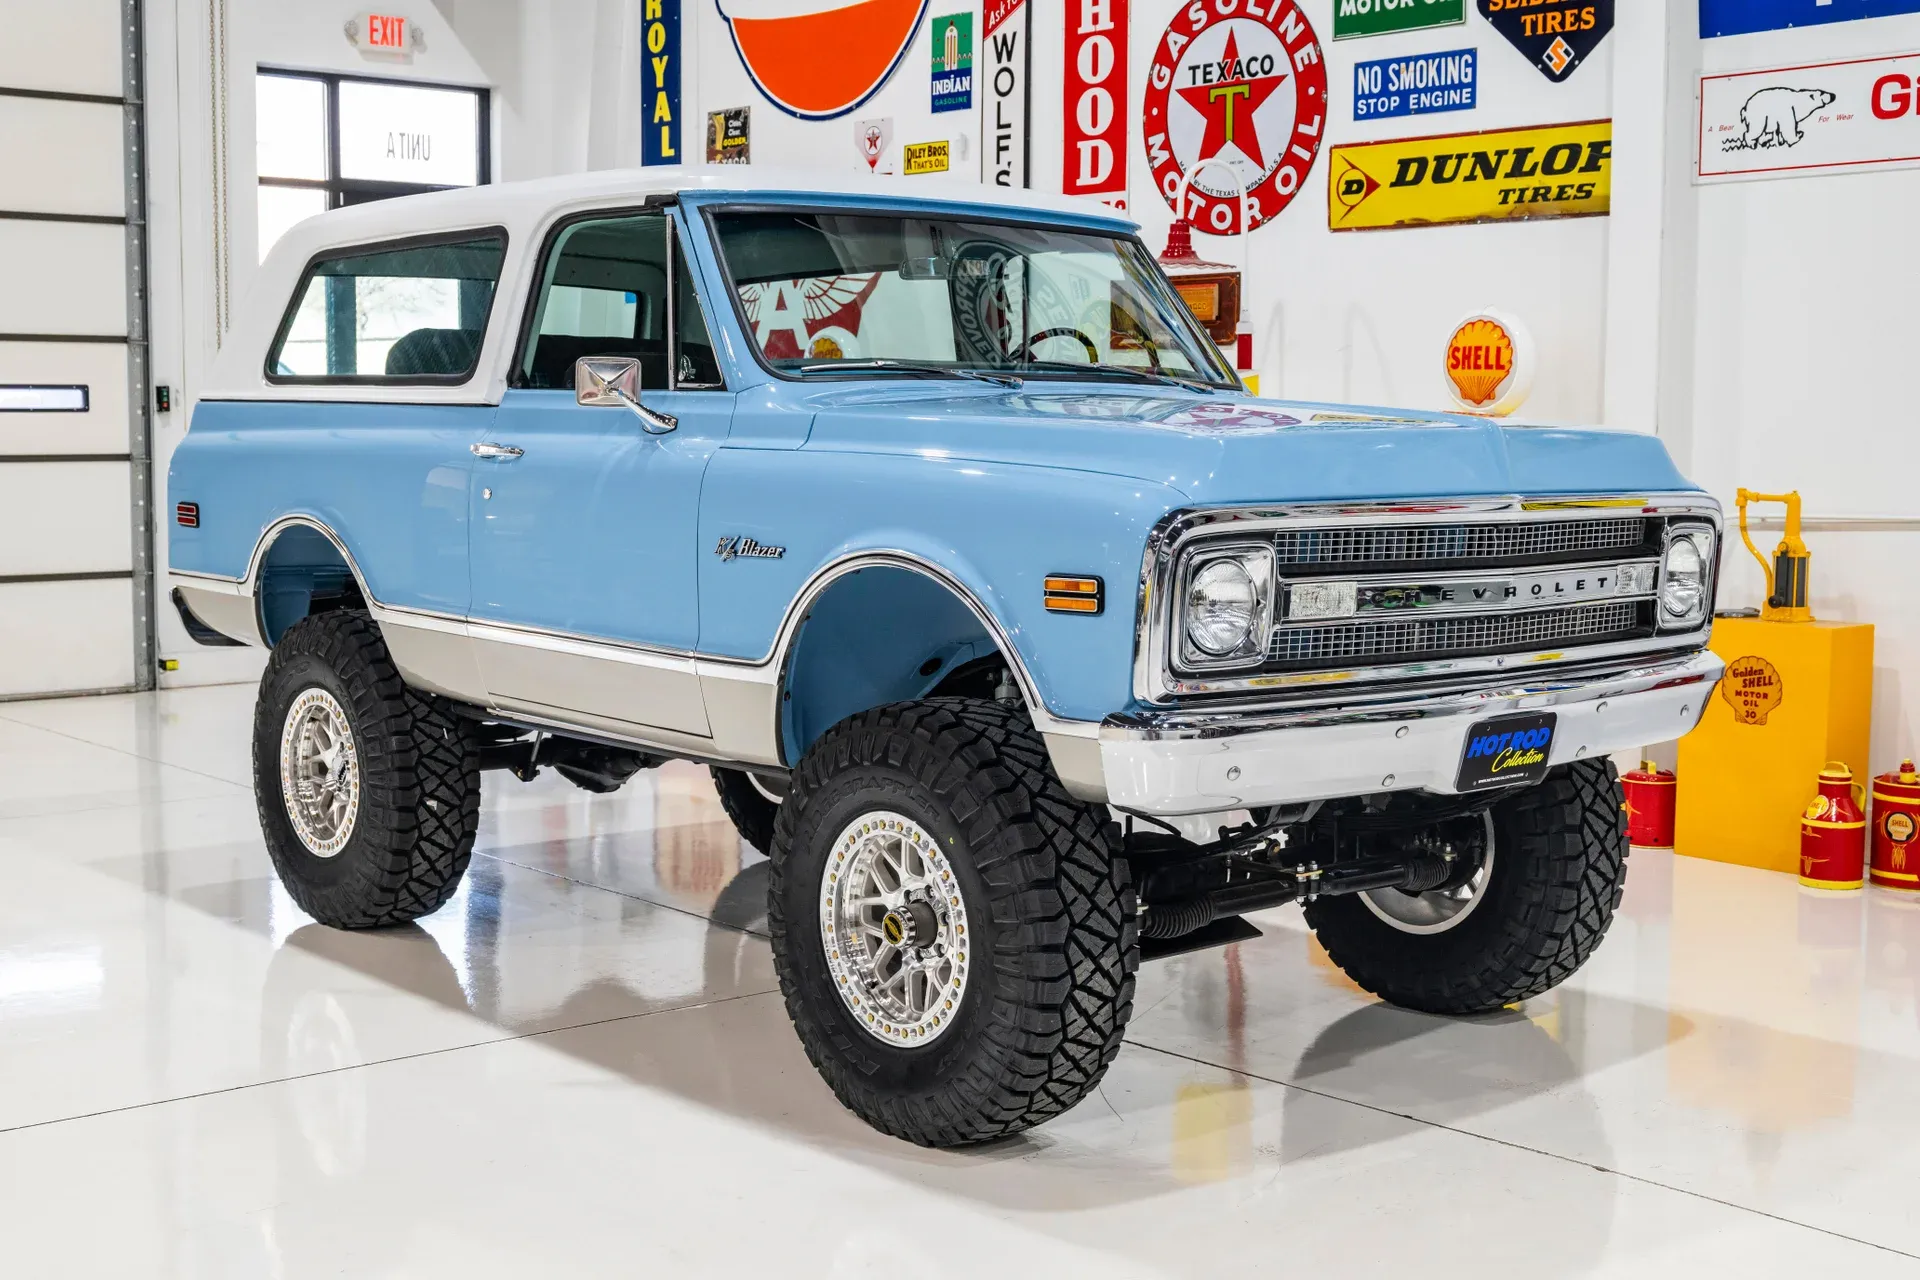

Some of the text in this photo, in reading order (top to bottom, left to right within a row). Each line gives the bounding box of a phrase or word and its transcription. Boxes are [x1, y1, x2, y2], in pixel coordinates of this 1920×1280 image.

[369, 15, 404, 47] EXIT
[1521, 6, 1596, 36] TIRES
[1188, 53, 1275, 86] TEXACO
[1357, 54, 1473, 95] NO SMOKING
[934, 96, 968, 106] GASOLINE
[1357, 88, 1472, 115] STOP ENGINE
[1718, 124, 1735, 132] Bear
[1818, 113, 1854, 123] For Wear
[906, 147, 927, 170] RILEY
[934, 158, 945, 168] OIL
[1202, 184, 1214, 195] THE
[1215, 189, 1235, 197] TEXAS
[1498, 182, 1596, 206] TIRES
[1450, 345, 1506, 371] SHELL
[737, 538, 786, 558] Blazer
[1373, 577, 1608, 605] CHEVROLET
[1733, 666, 1764, 678] Golden
[1742, 675, 1774, 688] SHELL
[1735, 690, 1768, 700] MOTOR
[1743, 700, 1759, 708] OIL
[1745, 710, 1757, 719] 30
[1467, 726, 1551, 759] HOT ROD
[1491, 746, 1545, 773] Collection
[1891, 819, 1909, 828] SHELL
